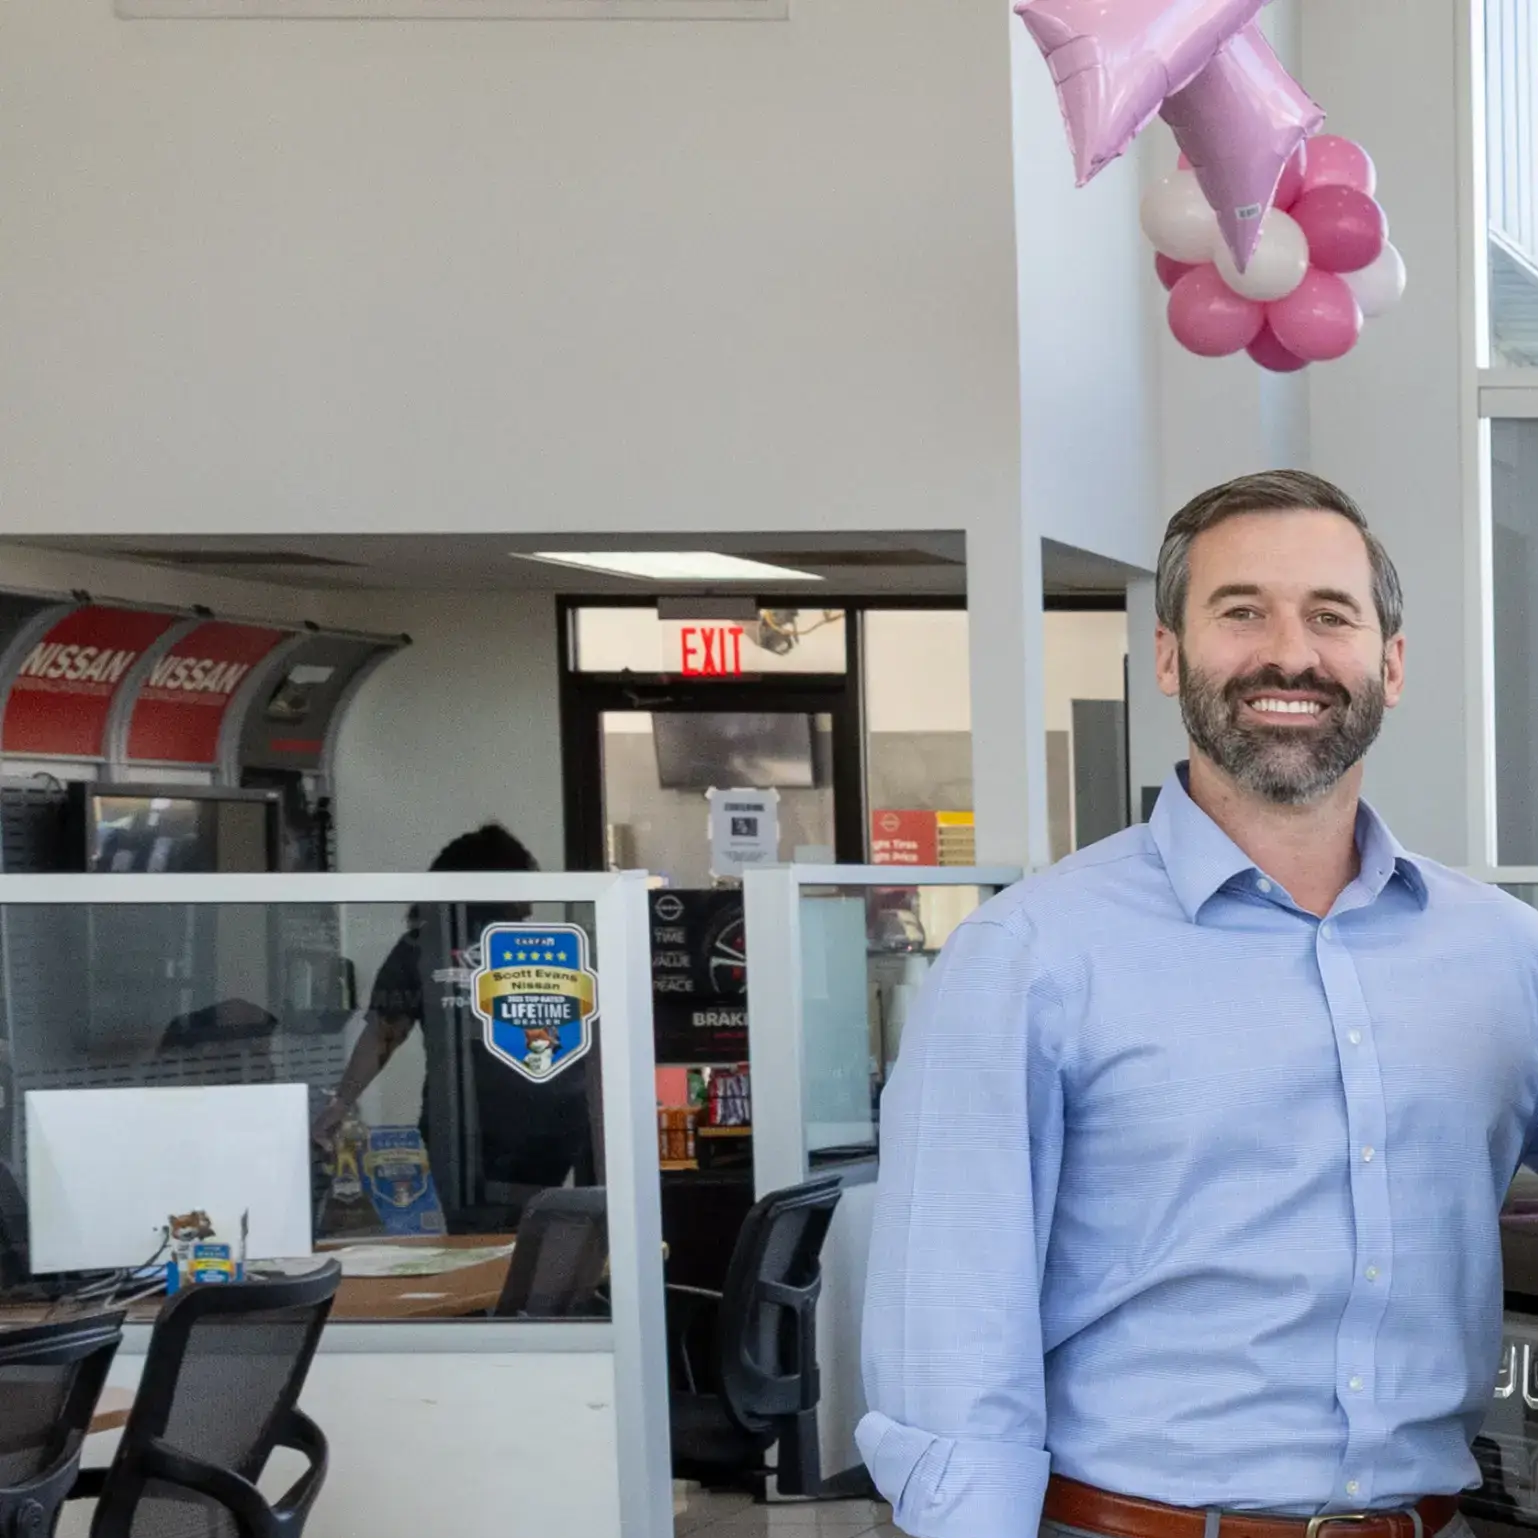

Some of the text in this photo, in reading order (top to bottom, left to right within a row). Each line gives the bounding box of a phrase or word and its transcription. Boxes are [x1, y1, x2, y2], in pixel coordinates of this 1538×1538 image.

[19, 642, 136, 683] NISSAN
[681, 626, 744, 677] EXIT
[149, 655, 250, 694] NISSAN
[493, 968, 578, 982] Scott Evans
[511, 980, 561, 990] Nissan
[501, 1003, 572, 1019] LIFETIME
